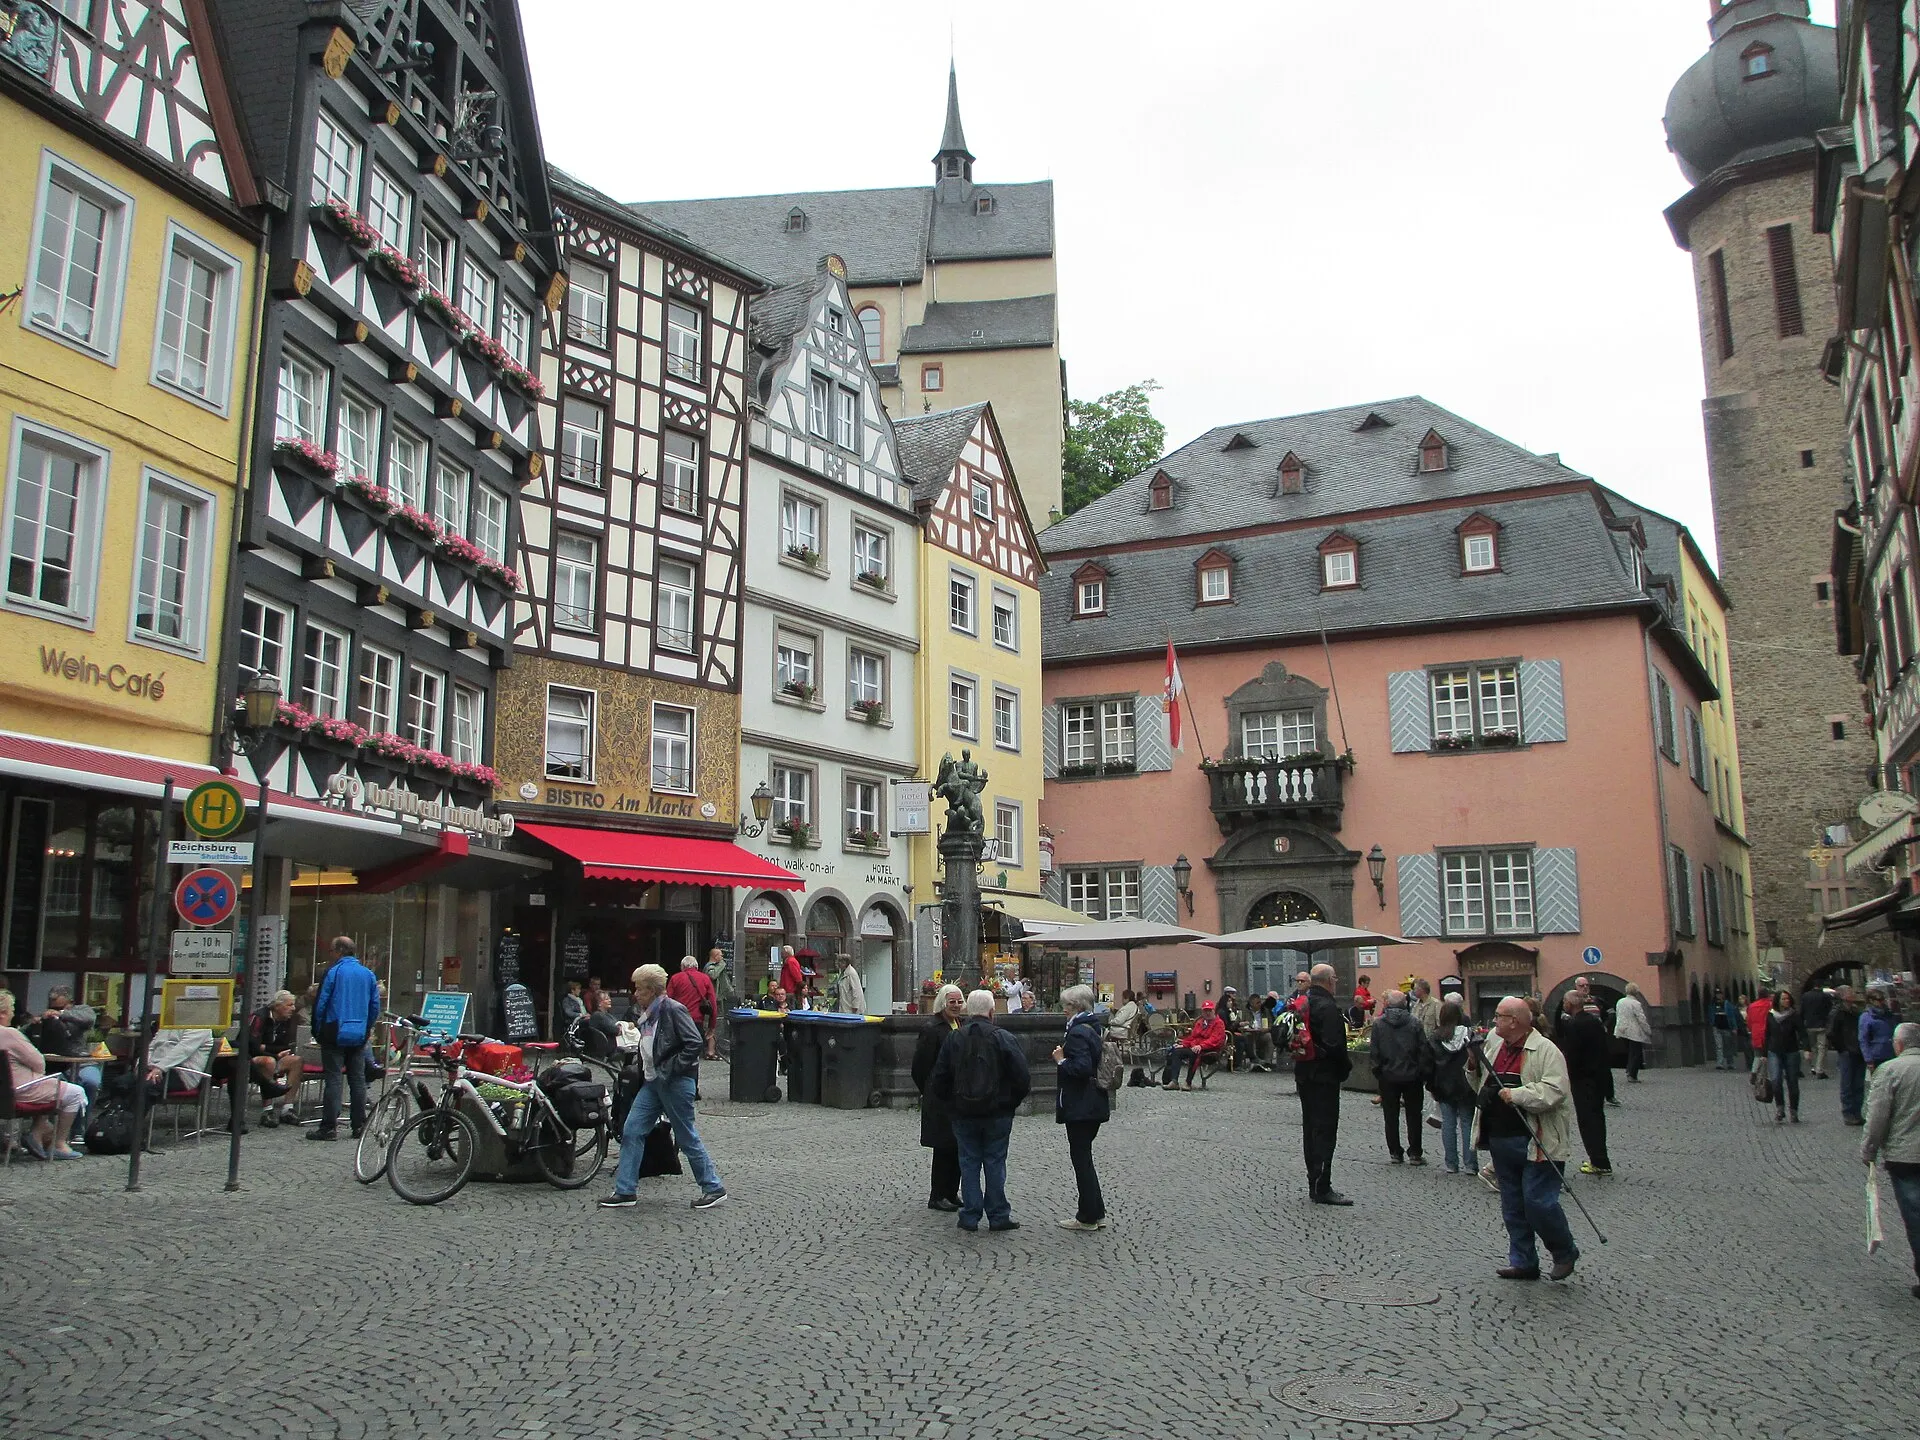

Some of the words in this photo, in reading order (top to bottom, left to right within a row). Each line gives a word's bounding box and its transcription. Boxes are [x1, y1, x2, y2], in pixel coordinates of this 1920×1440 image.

[39, 644, 165, 701] Wein-Café
[365, 781, 442, 820] brillen
[546, 787, 605, 809] BISTRO
[611, 793, 640, 812] Am
[643, 796, 695, 818] Markt
[201, 793, 228, 824] H
[172, 842, 237, 854] Reichsburg
[872, 863, 893, 875] HOTEL
[865, 874, 876, 885] AM
[877, 875, 900, 886] MARKT
[184, 937, 190, 946] 6
[202, 937, 212, 947] 10
[215, 938, 220, 946] h
[201, 950, 229, 958] Entladen
